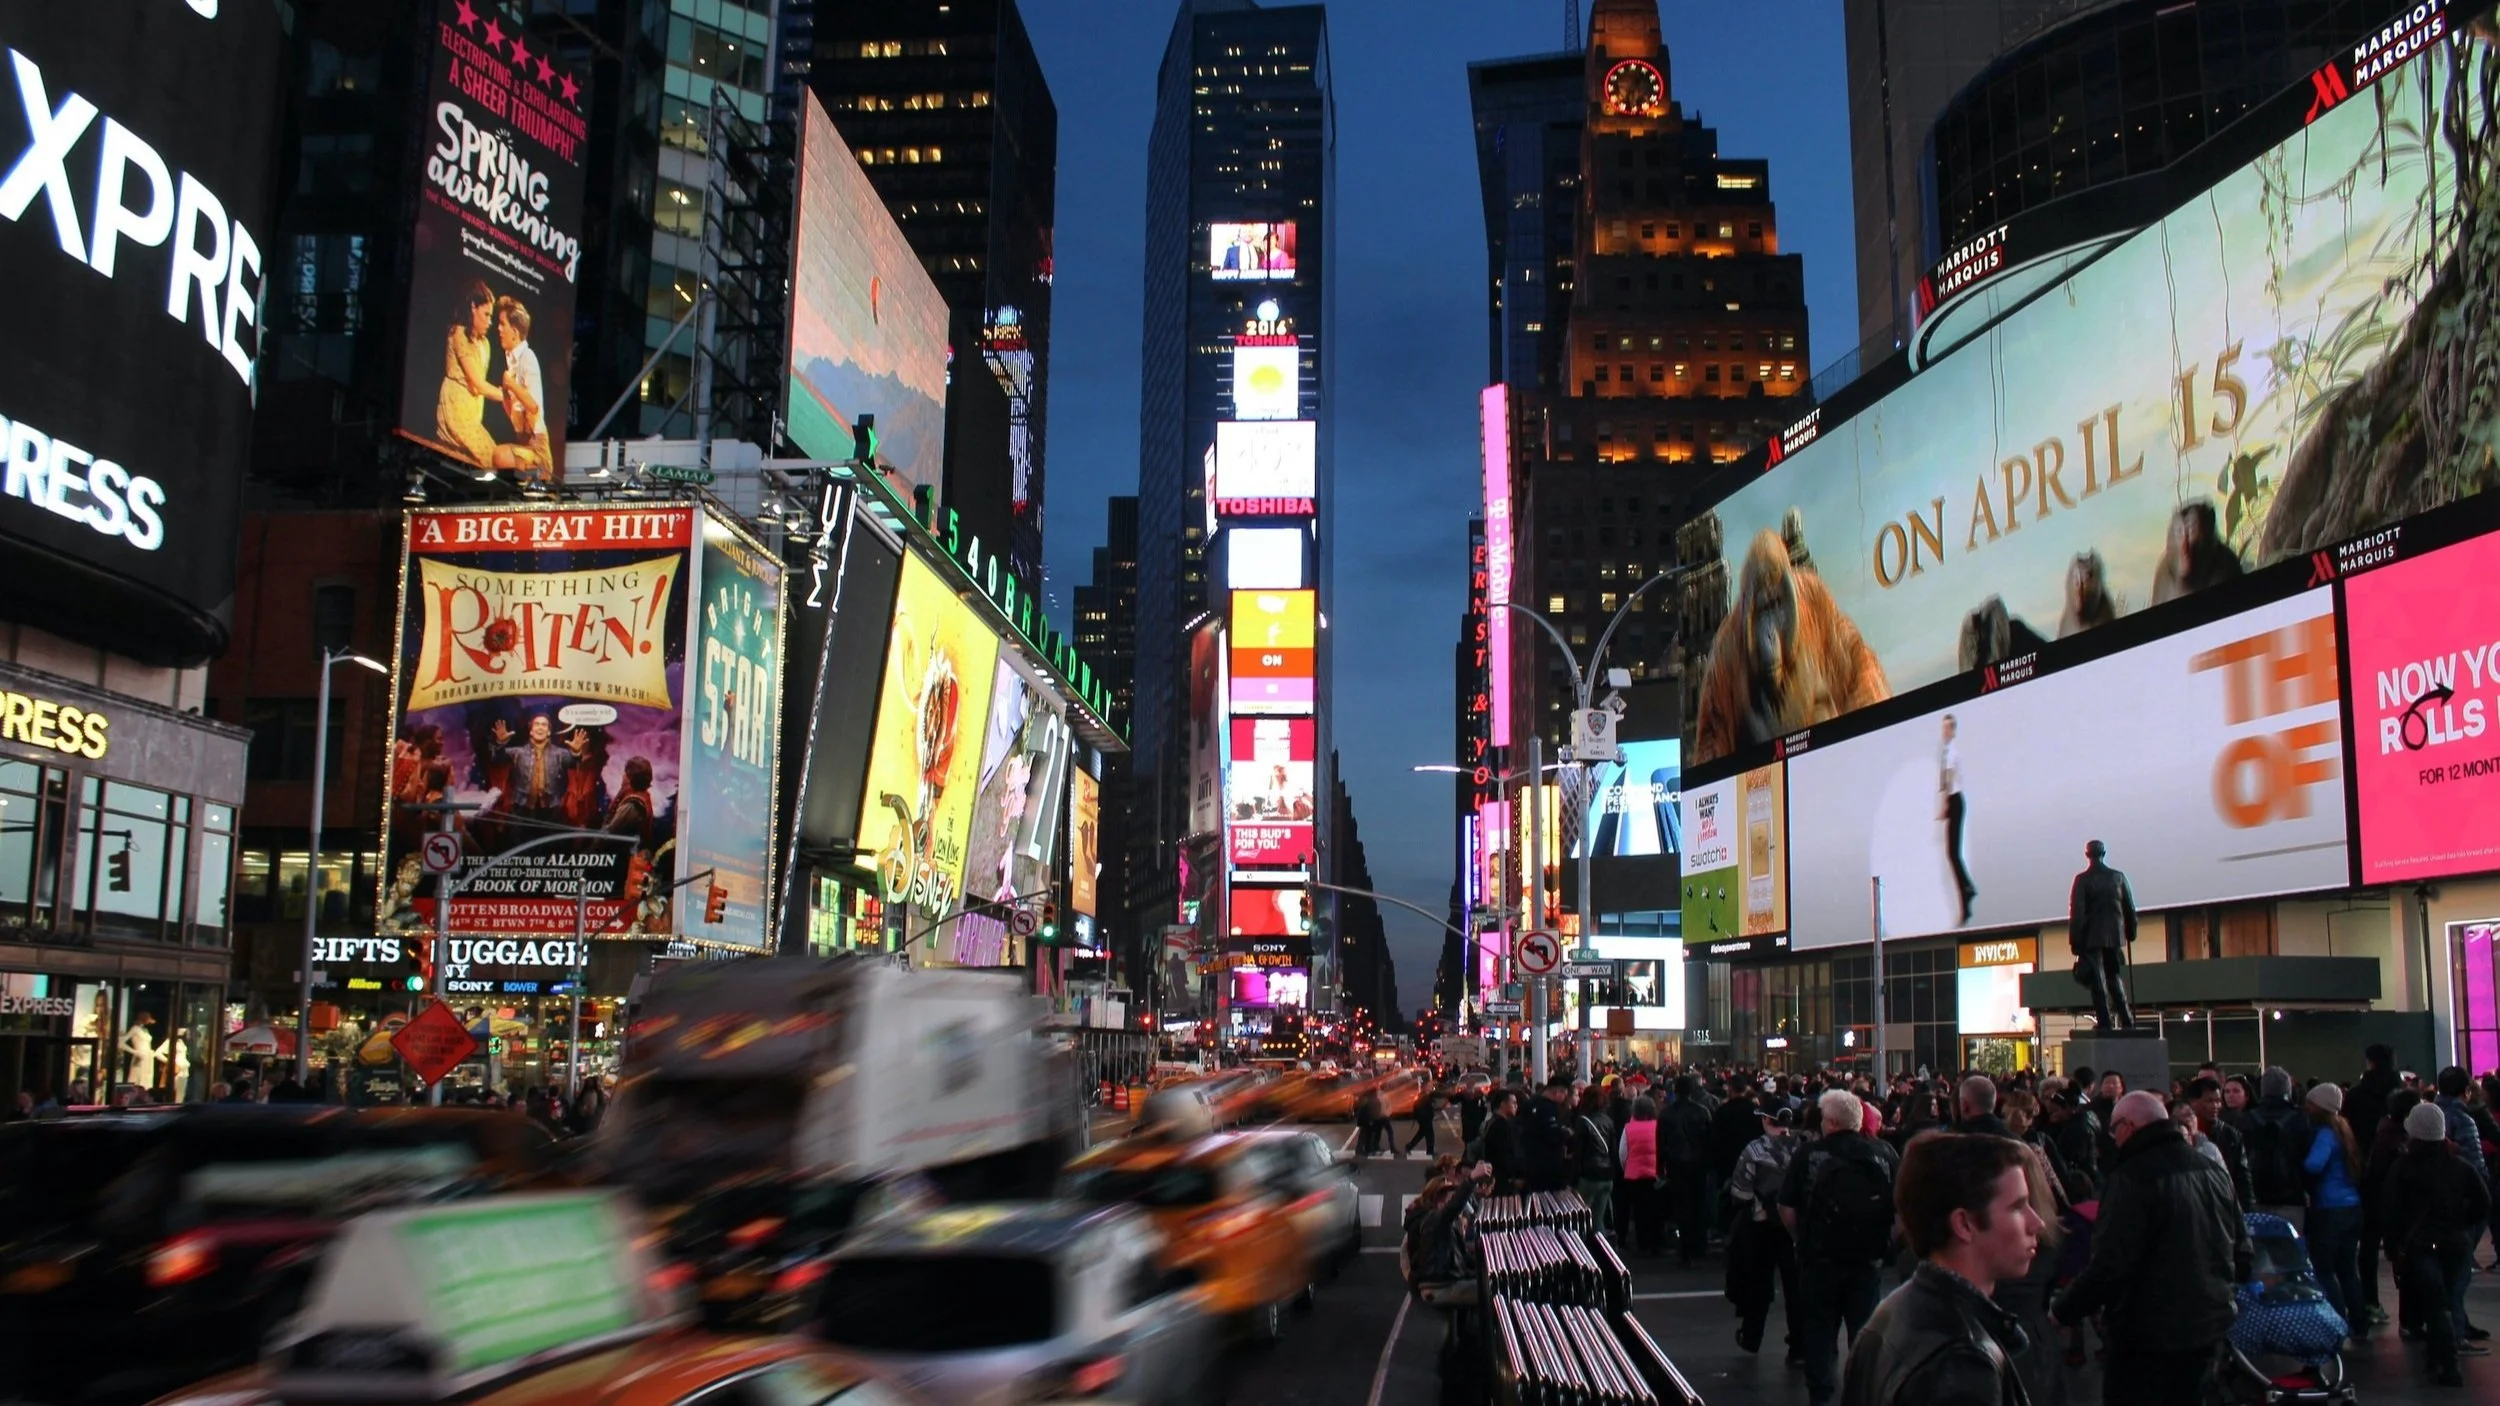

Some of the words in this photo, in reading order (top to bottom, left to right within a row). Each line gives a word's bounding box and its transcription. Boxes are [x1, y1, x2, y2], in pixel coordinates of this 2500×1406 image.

[2354, 0, 2450, 63] MARRIOT
[2356, 17, 2442, 86] MARQUIS
[449, 57, 459, 87] A
[462, 66, 507, 118] SHEER
[513, 79, 520, 95] &
[436, 101, 550, 211] SPRING
[427, 155, 581, 283] awakening
[1937, 225, 2008, 279] MARRIOTT
[1939, 251, 1999, 298] MARQUIS
[1235, 335, 1298, 346] TOSHIBA
[1784, 408, 1820, 441] MARRIOTT
[1784, 425, 1816, 455] MARQUIS
[1873, 496, 1946, 590] ON
[1965, 402, 2144, 553] APRIL
[2175, 338, 2247, 456] 15
[0, 414, 166, 550] RESS
[1217, 498, 1315, 514] TOSHIBA
[530, 516, 593, 542] FAT
[2339, 526, 2400, 558] MARRIOTT
[2340, 545, 2394, 573] MARQUIS
[455, 570, 641, 597] SOMETHING
[1474, 545, 1487, 667] ERNST
[707, 583, 772, 660] BRIGHT
[1004, 573, 1111, 722] BROADWAY
[1262, 655, 1283, 667] ON
[2000, 652, 2037, 672] MARRIOTT
[2000, 665, 2033, 684] MARQUIS
[2376, 653, 2457, 710] NOW
[508, 678, 573, 691] HILARIOUS
[577, 680, 601, 693] NEW
[607, 684, 651, 700] SMASH!
[701, 636, 768, 768] STAR
[1474, 693, 1488, 711] &
[0, 690, 108, 759] RESS
[2379, 699, 2486, 755] ROLLS
[1785, 729, 1811, 745] MARRIOTT
[1786, 741, 1808, 755] MARQUIS
[2419, 767, 2445, 786] FOR
[2449, 764, 2461, 781] 12
[1608, 783, 1664, 796] COND
[1698, 792, 1719, 809] ALWAYS
[1700, 806, 1715, 820] WANT
[1234, 828, 1258, 838] THIS
[1235, 839, 1255, 849] FOR
[467, 856, 485, 866] THE
[533, 856, 546, 866] OF
[546, 854, 616, 867] ALADDIN
[1690, 846, 1721, 868] swatch
[490, 868, 508, 878] THE
[510, 869, 570, 879] CO-DIRECTOR
[572, 868, 584, 878] OF
[449, 879, 469, 893] HE
[474, 880, 516, 893] BOOK
[520, 880, 541, 893] OF
[448, 903, 620, 918] OTTENBROADWACOM
[492, 918, 526, 926] BTWN
[547, 918, 555, 927] &
[584, 918, 605, 927] VES
[312, 937, 401, 963] GIFTS
[430, 940, 588, 967] UGGAGE
[1253, 944, 1287, 952] SONY
[1573, 950, 1579, 959] W
[1974, 941, 2019, 963] INVICTA
[1590, 966, 1609, 974] WAY
[348, 978, 382, 989] Nikon
[448, 981, 493, 991] SONY
[503, 982, 537, 992] BOWER
[1, 995, 73, 1017] EXPRESS
[1693, 1029, 1710, 1042] 1515
